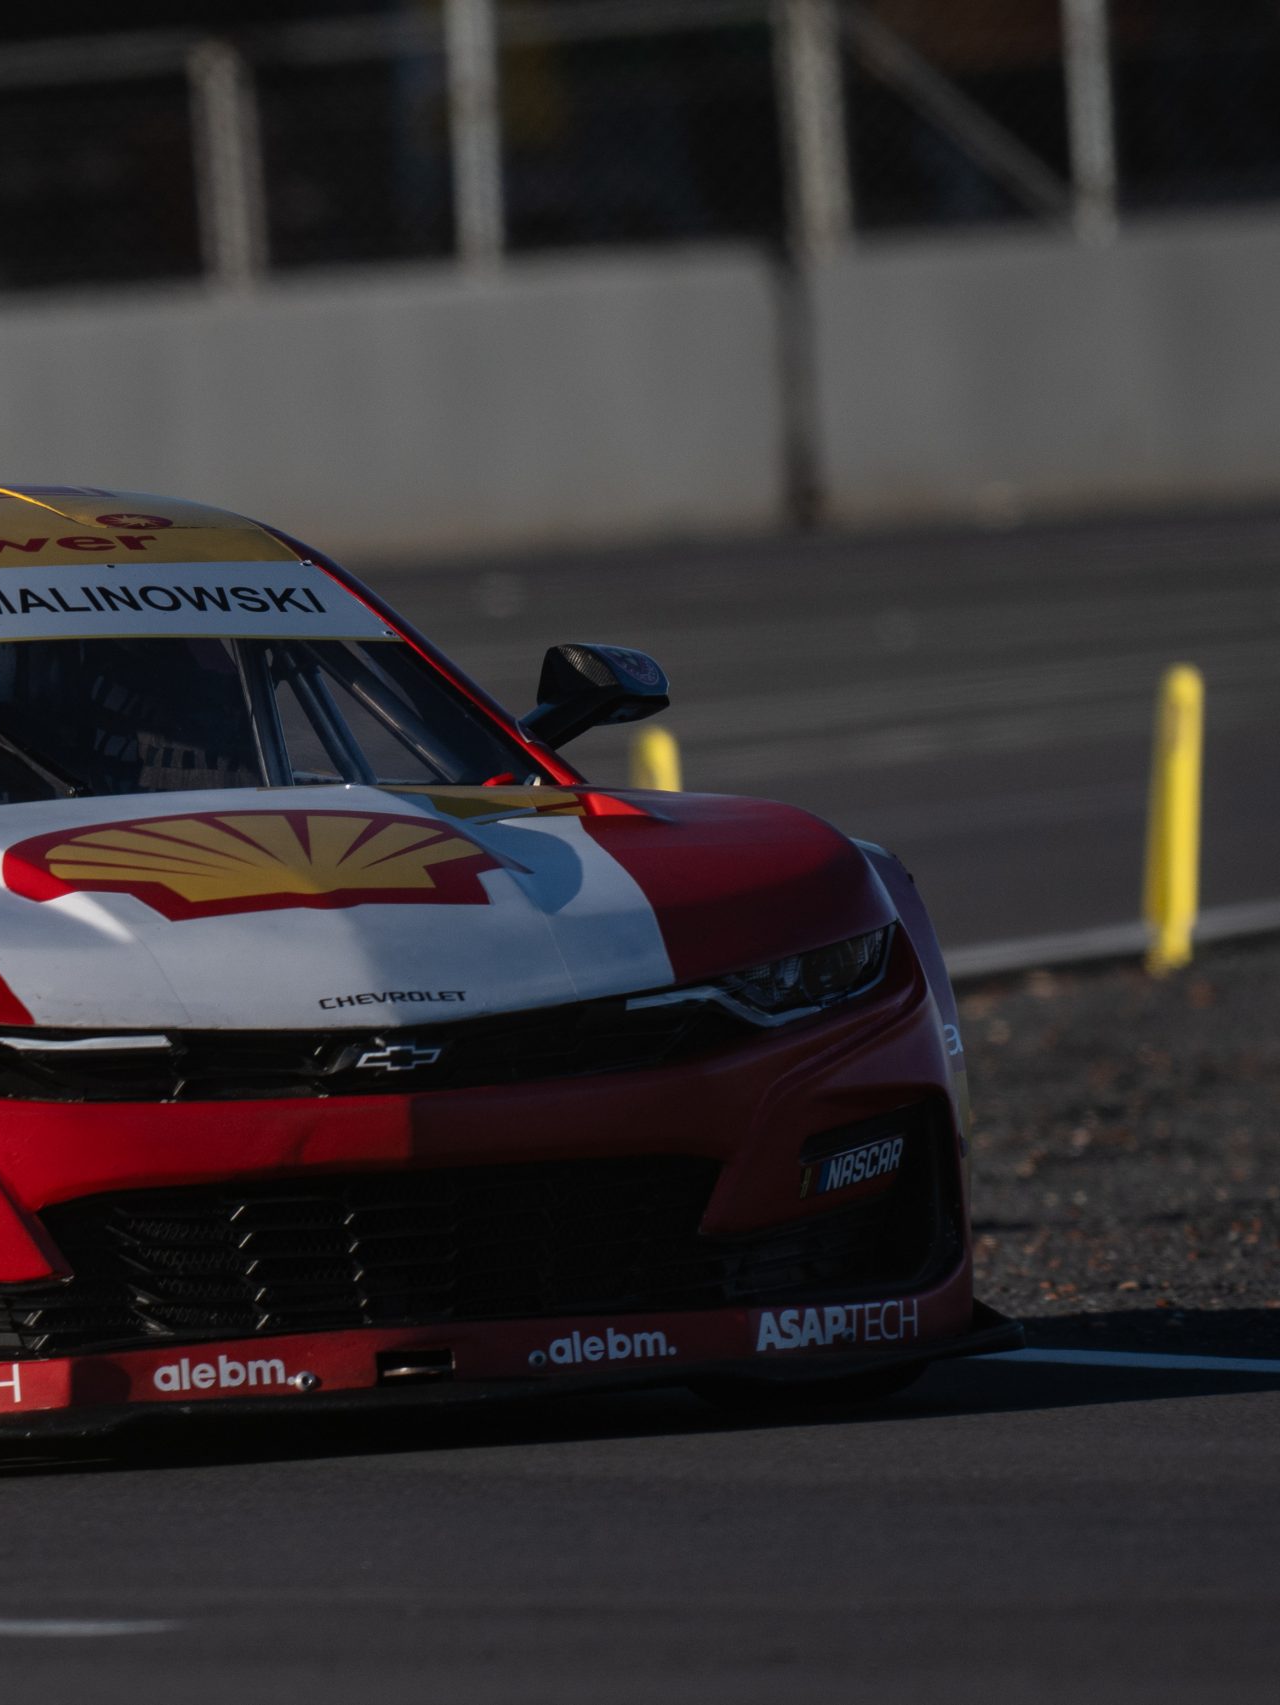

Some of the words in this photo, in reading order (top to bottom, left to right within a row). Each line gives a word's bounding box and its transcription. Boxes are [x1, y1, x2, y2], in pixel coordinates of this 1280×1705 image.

[319, 990, 466, 1009] CHEVROLET
[825, 1137, 904, 1192] NASCAR
[549, 1328, 678, 1365] alebm.
[756, 1299, 919, 1352] ASAPTECH
